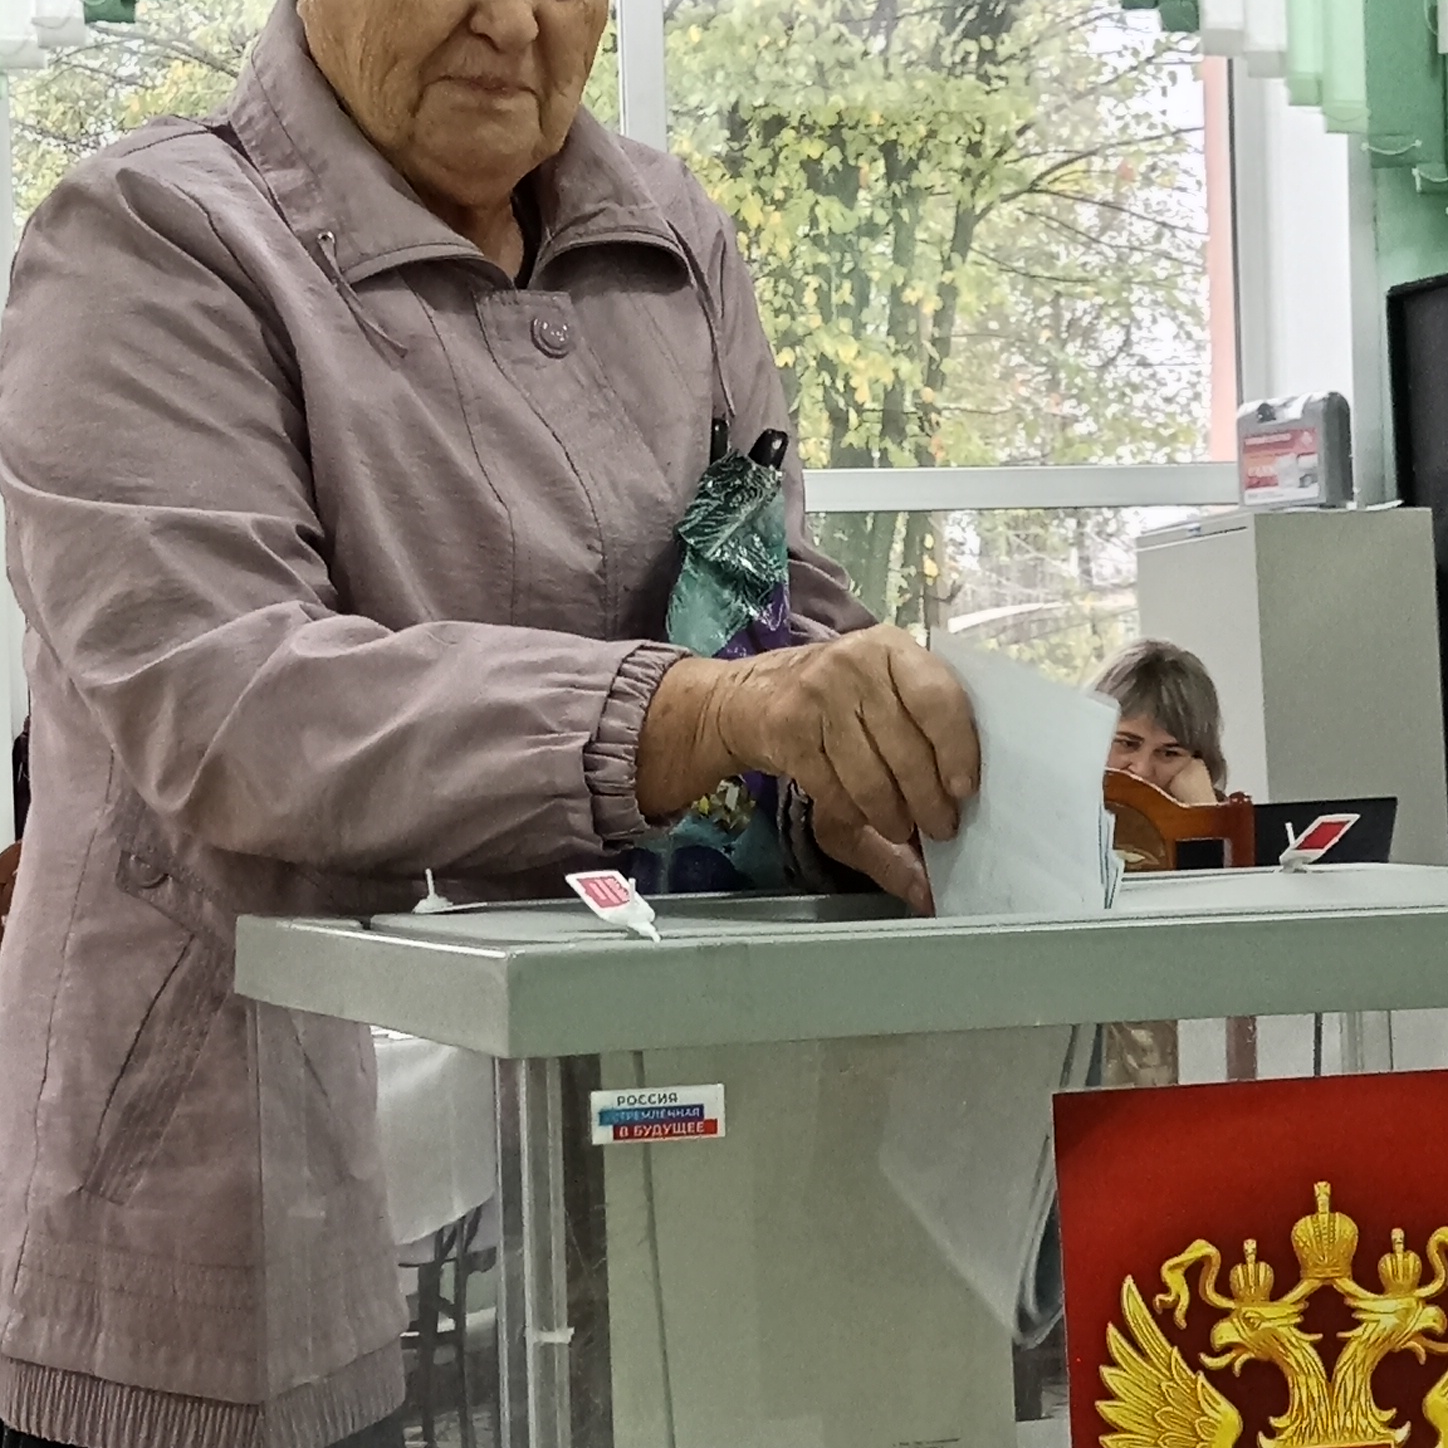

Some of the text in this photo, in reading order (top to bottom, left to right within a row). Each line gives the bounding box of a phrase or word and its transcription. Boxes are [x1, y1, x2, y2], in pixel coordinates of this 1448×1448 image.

[617, 1093, 678, 1106] РОССИЯ
[619, 1121, 704, 1137] В БУДУЩЕЕ
